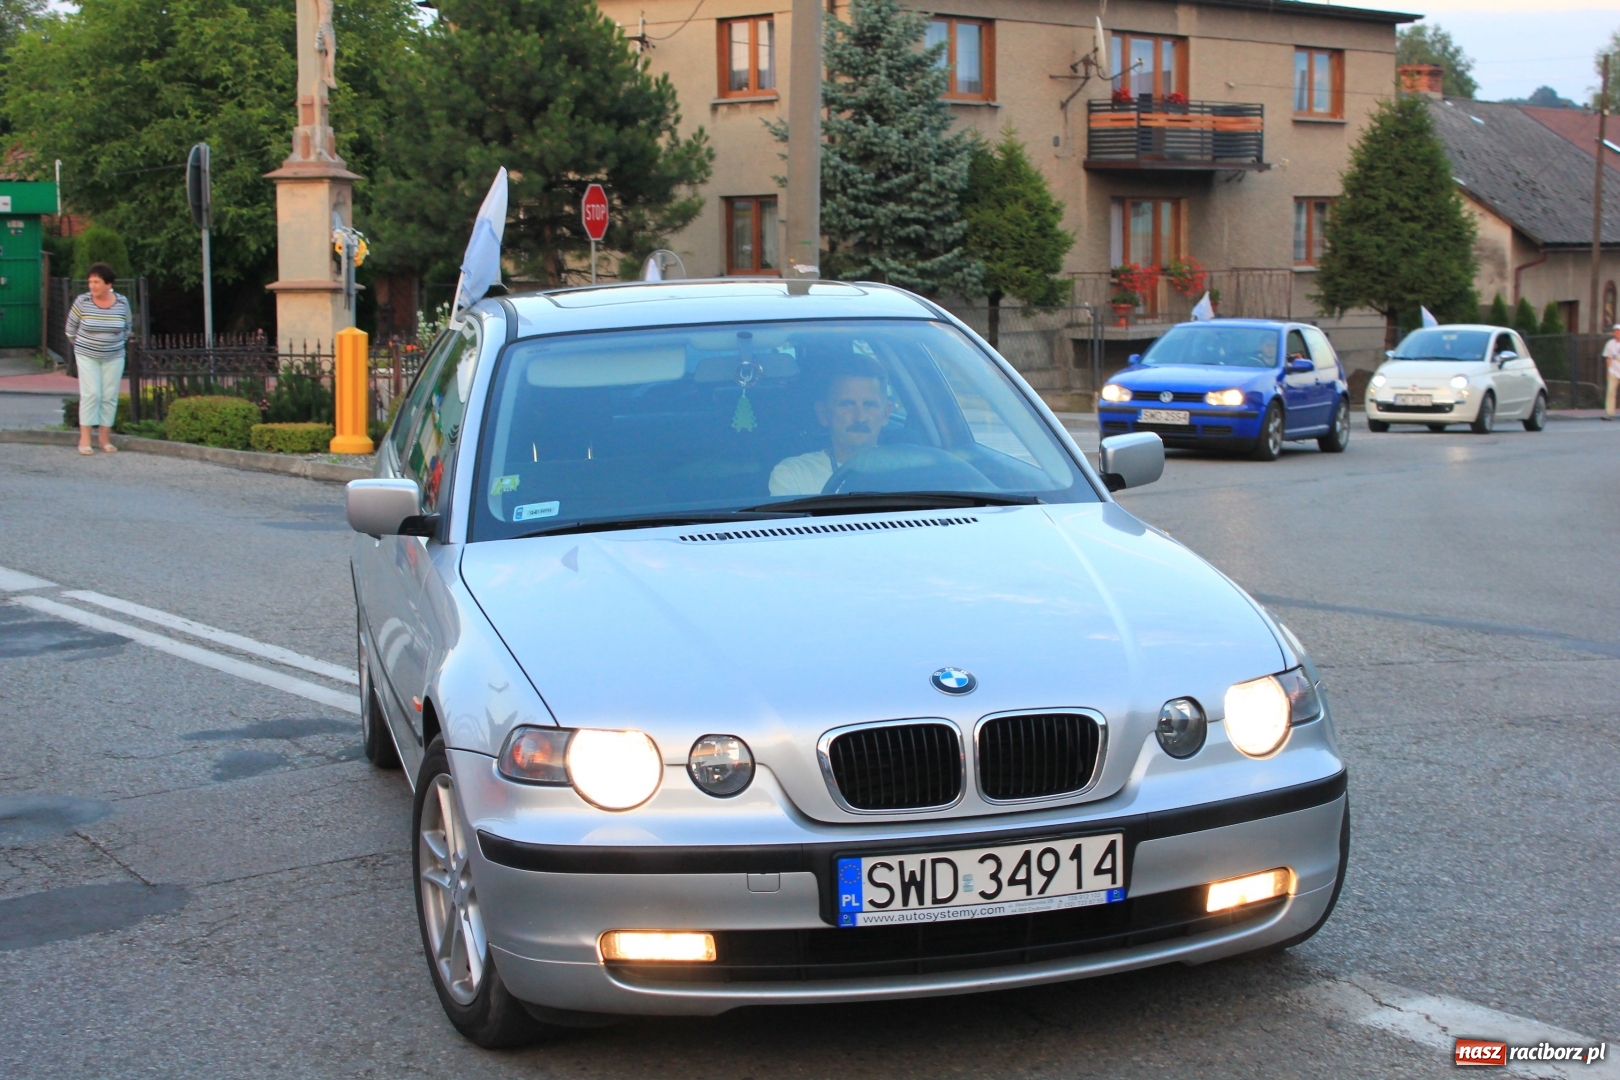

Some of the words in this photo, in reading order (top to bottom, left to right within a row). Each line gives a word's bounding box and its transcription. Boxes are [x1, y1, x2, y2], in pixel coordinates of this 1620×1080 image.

[586, 203, 606, 221] STOP
[867, 856, 959, 909] SWD
[978, 839, 1118, 901] 34914
[842, 894, 860, 908] PL
[863, 905, 1006, 924] www.autosystemy.com
